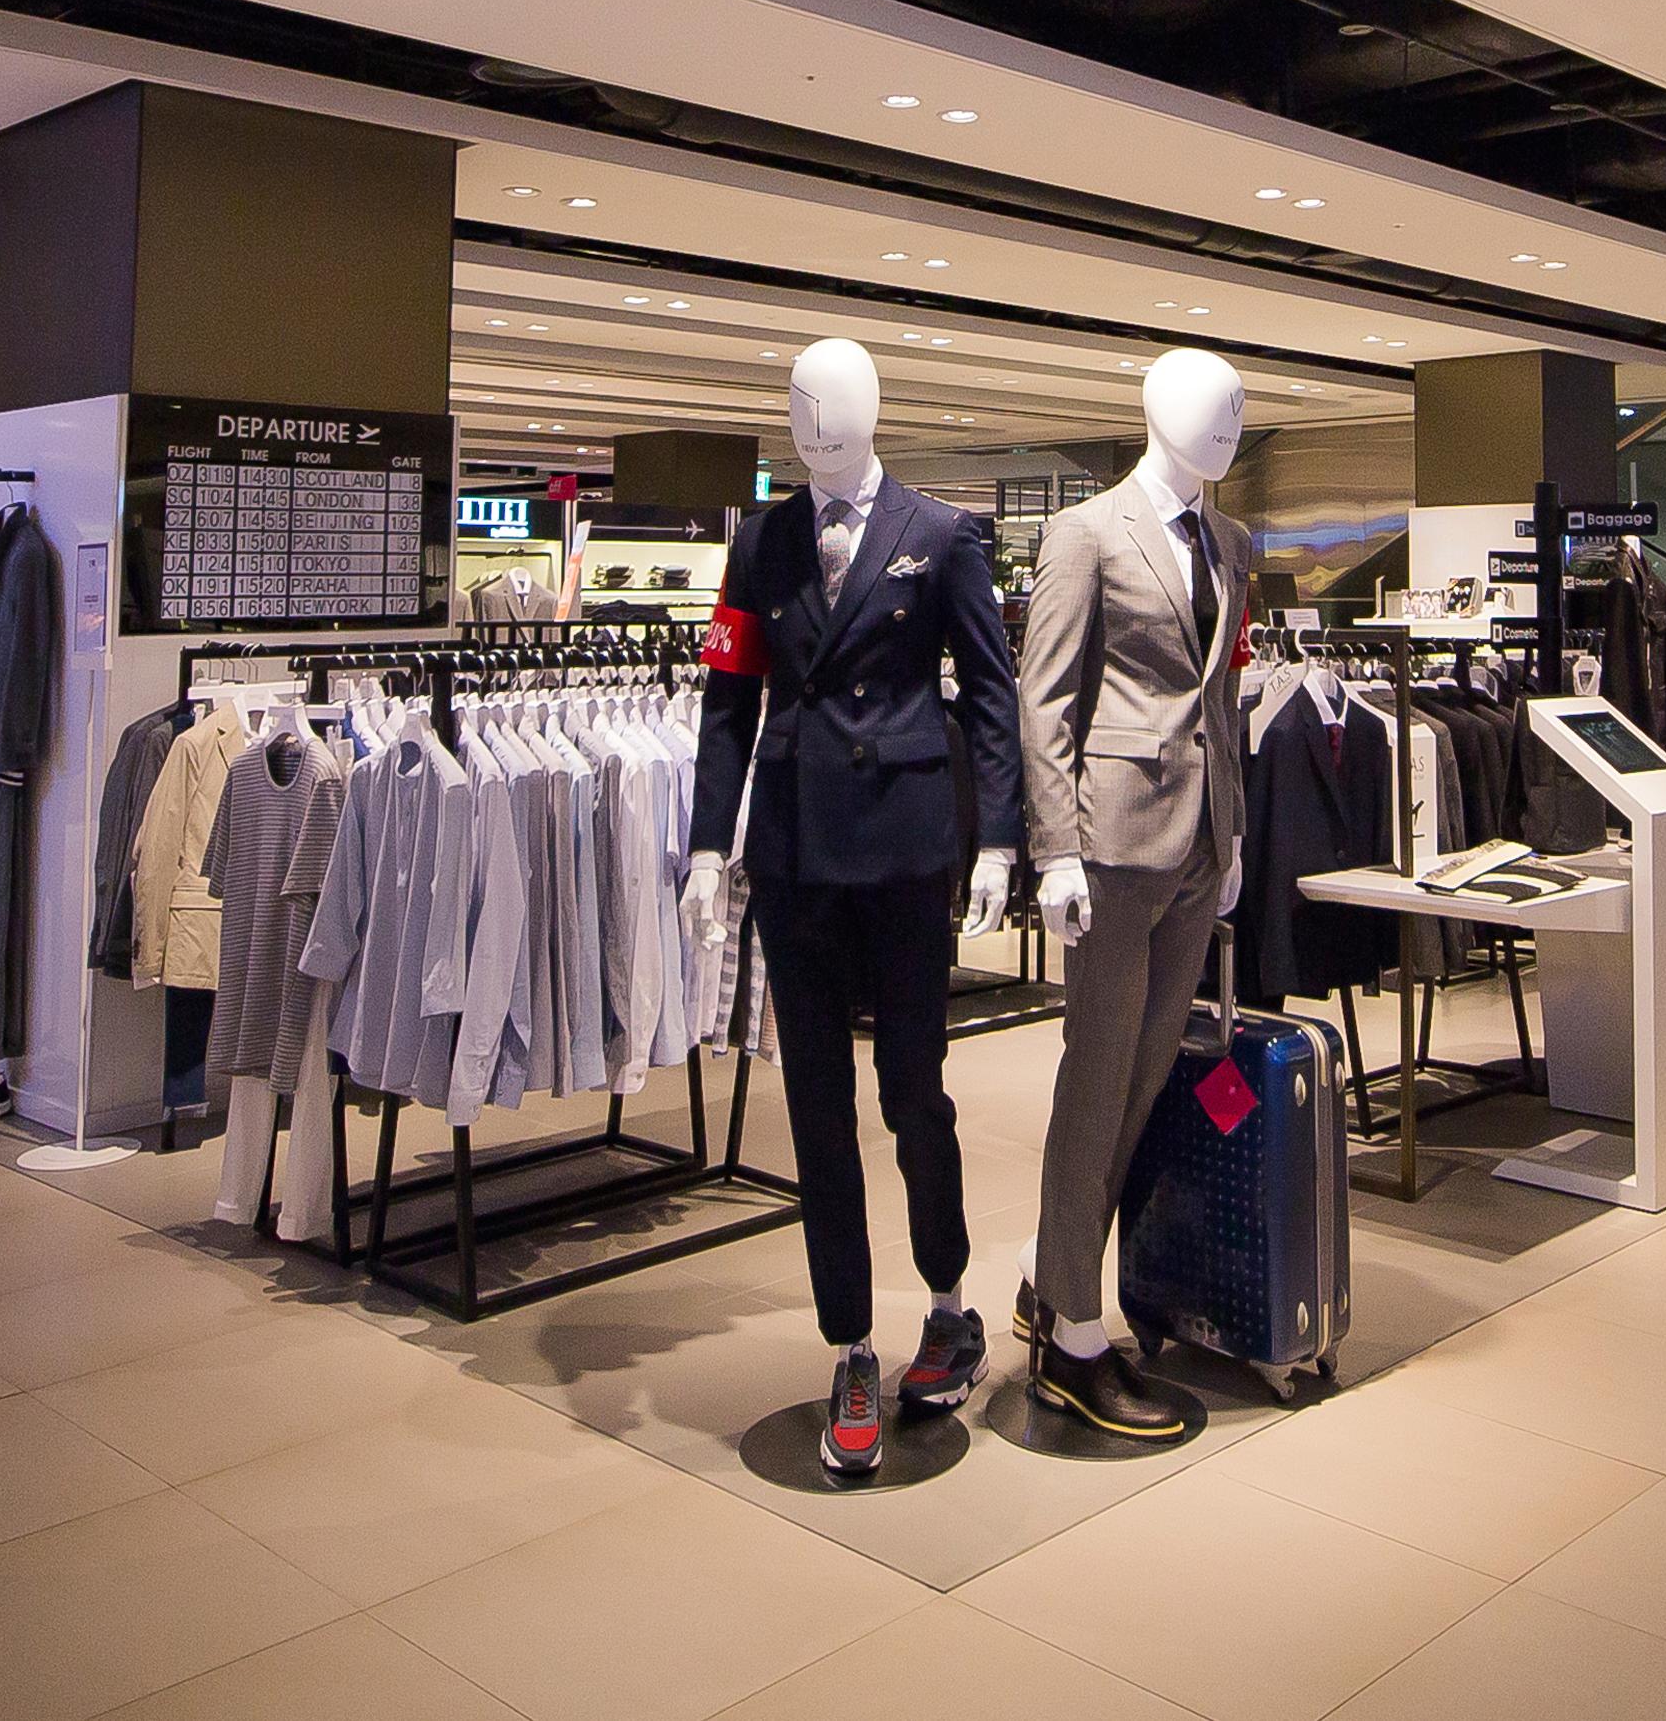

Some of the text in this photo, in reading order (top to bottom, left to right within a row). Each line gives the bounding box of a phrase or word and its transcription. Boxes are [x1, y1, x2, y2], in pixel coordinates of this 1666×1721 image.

[218, 415, 350, 443] DEPARTURE
[167, 446, 422, 468] FLIGHT TIME FROM GATE
[168, 465, 192, 481] OZ
[199, 467, 233, 483] 319
[295, 471, 384, 488] SCOTLAND
[412, 476, 421, 490] 8
[168, 488, 191, 504] SC
[200, 489, 232, 505] 104
[295, 492, 364, 508] LONDON
[401, 495, 420, 510] 38
[166, 511, 190, 526] CZ
[197, 511, 232, 527] 607
[294, 514, 374, 529] BEIJING
[392, 516, 419, 531] 105
[1587, 513, 1653, 527] Baggage
[166, 533, 189, 549] KE
[196, 533, 231, 549] 833
[293, 535, 350, 551] PARIS
[400, 536, 419, 551] 37
[164, 556, 188, 571] UA
[198, 555, 230, 571] 124
[293, 556, 350, 571] TOKYO
[399, 557, 418, 571] 45
[163, 578, 186, 594] OK
[197, 578, 228, 594] 191
[291, 578, 349, 593] PRAHA
[390, 578, 418, 592] 110
[162, 601, 185, 616] KL
[194, 600, 228, 616] 856
[290, 599, 371, 614] NEWYORK
[390, 599, 417, 613] 127
